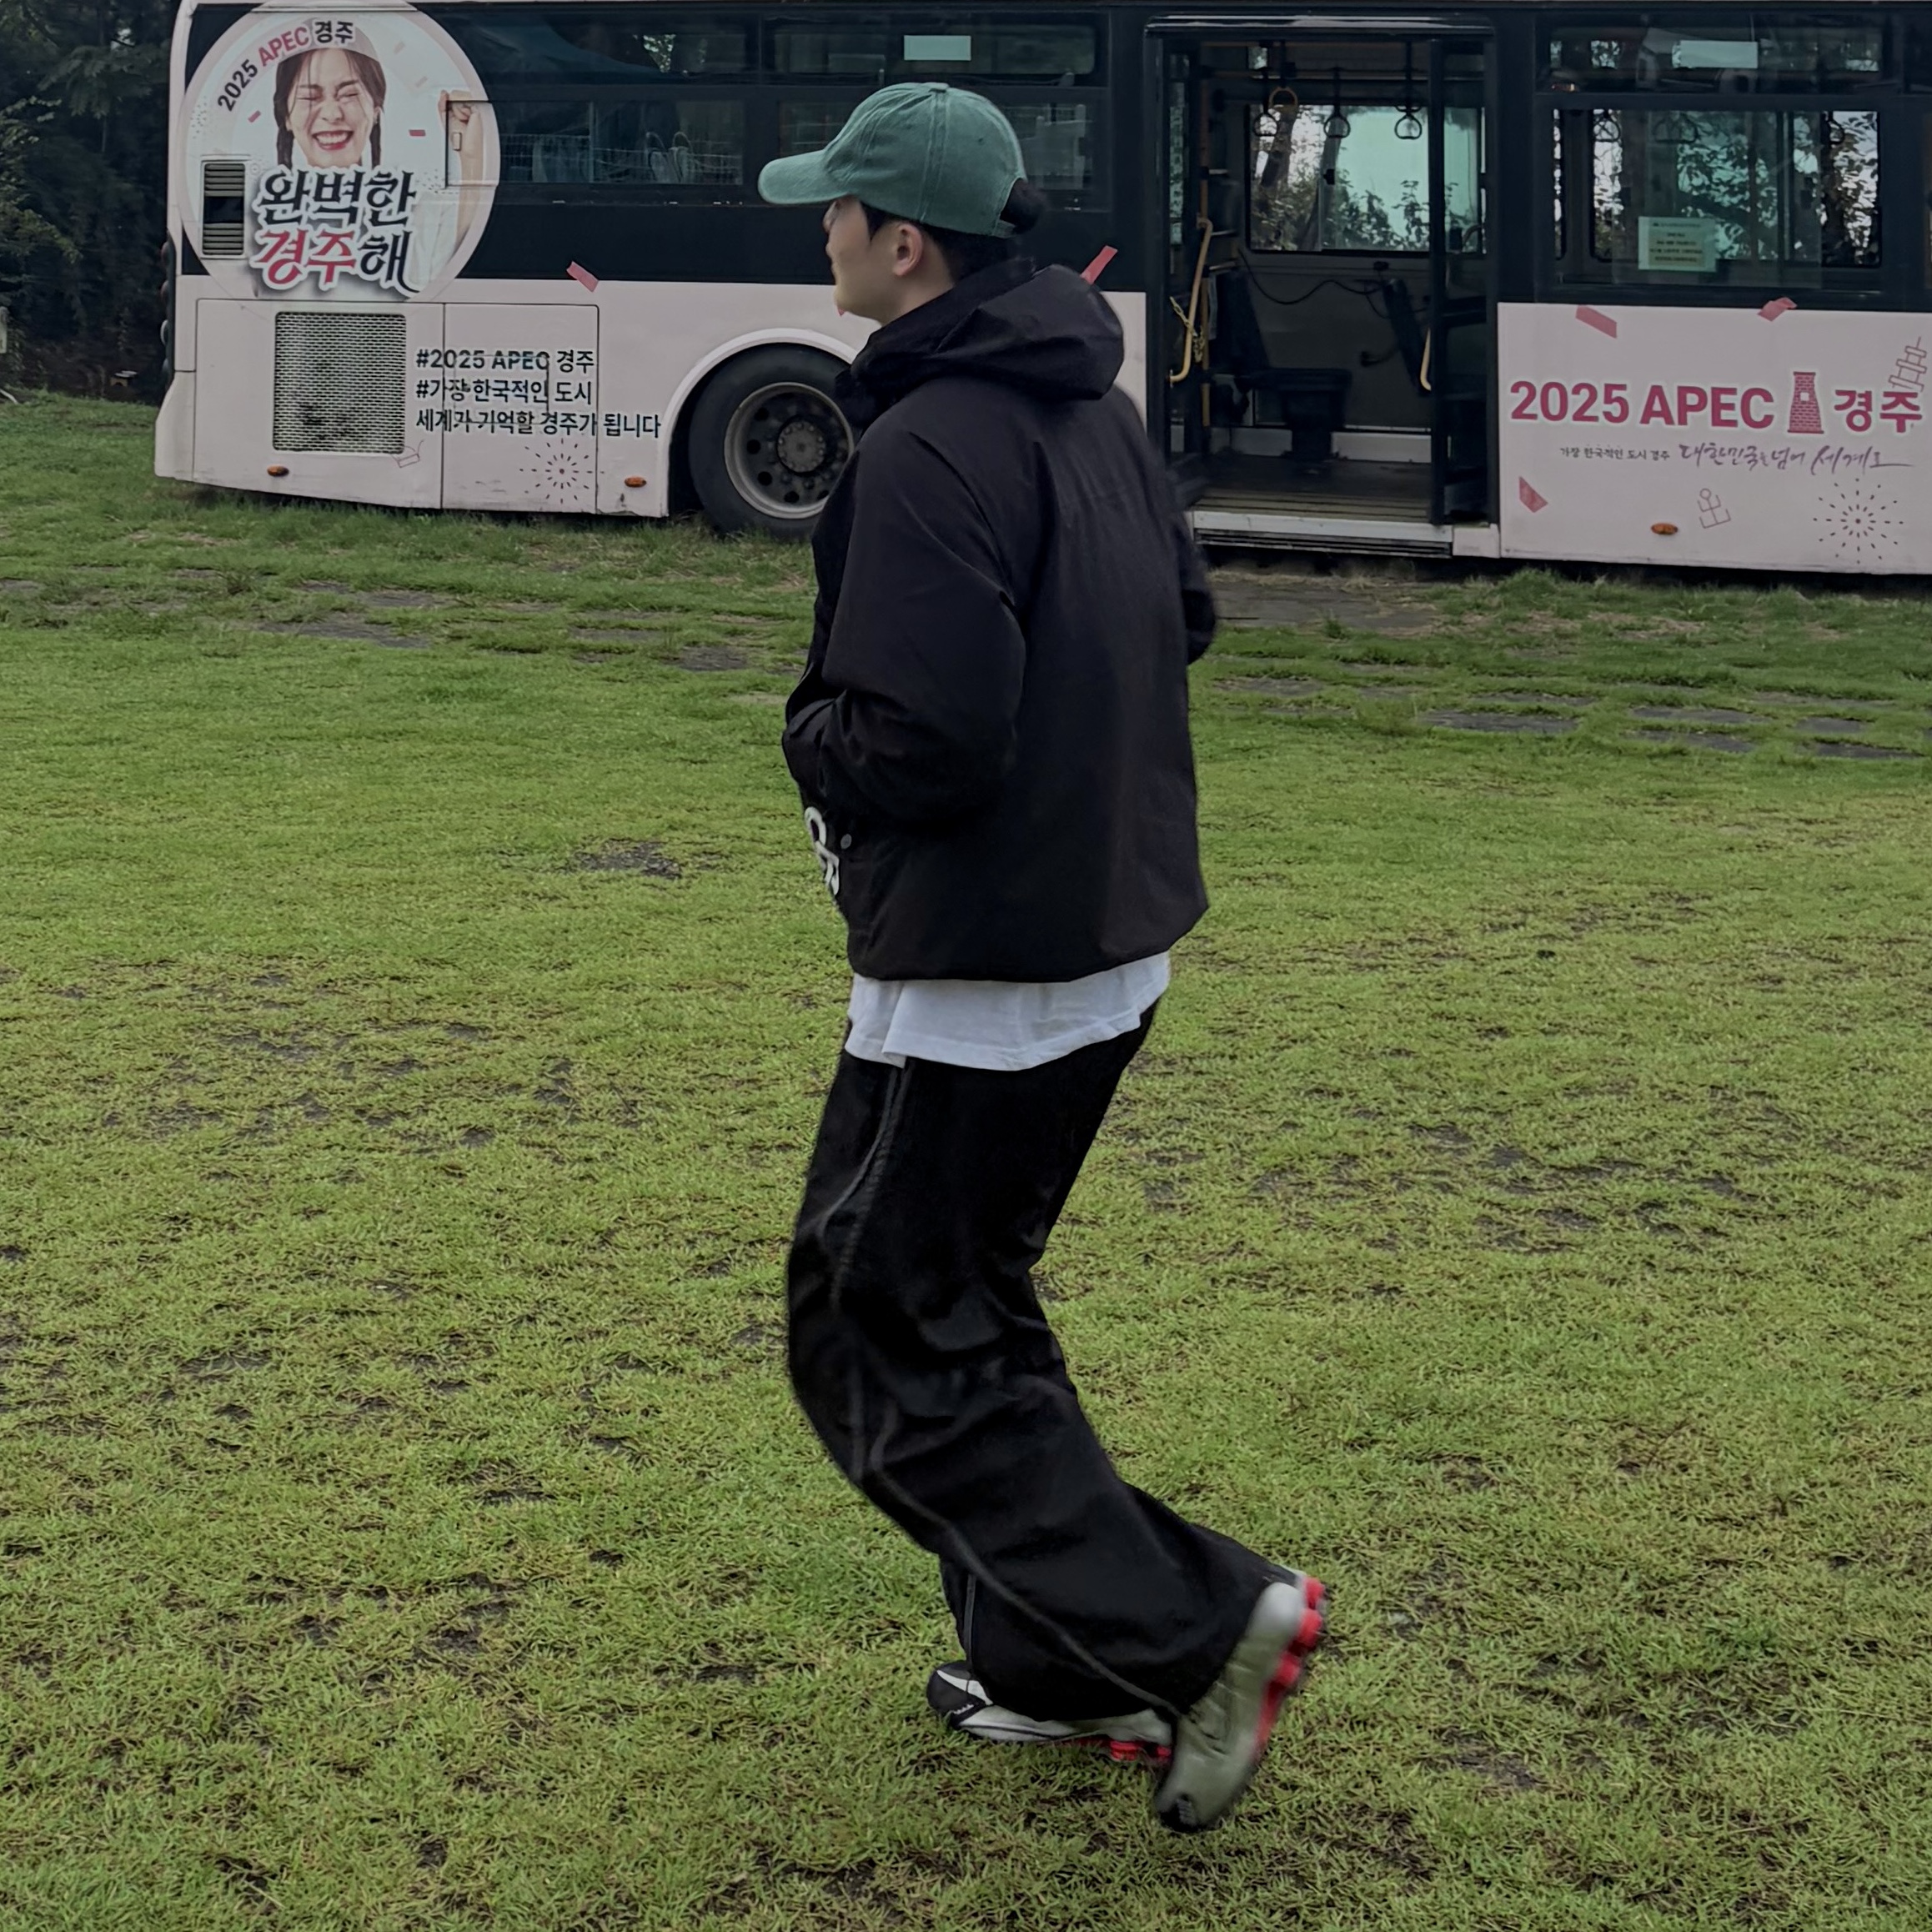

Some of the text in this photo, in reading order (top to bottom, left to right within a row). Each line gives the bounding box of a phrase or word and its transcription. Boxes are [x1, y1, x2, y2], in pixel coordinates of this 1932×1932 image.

[218, 20, 354, 112] 2025 APEC 경주
[258, 169, 416, 228] 완벽한
[254, 229, 420, 294] 경주해
[416, 349, 595, 374] #2025 APEC 경주
[416, 378, 591, 405] #가장 한국적인 도시
[1510, 380, 1923, 434] 2025 APEC 경주
[416, 409, 661, 439] 세계가 기억할 경주가 됩니다
[1559, 447, 1580, 459] 가장
[1627, 449, 1648, 460] 도시
[1650, 449, 1670, 461] 경주
